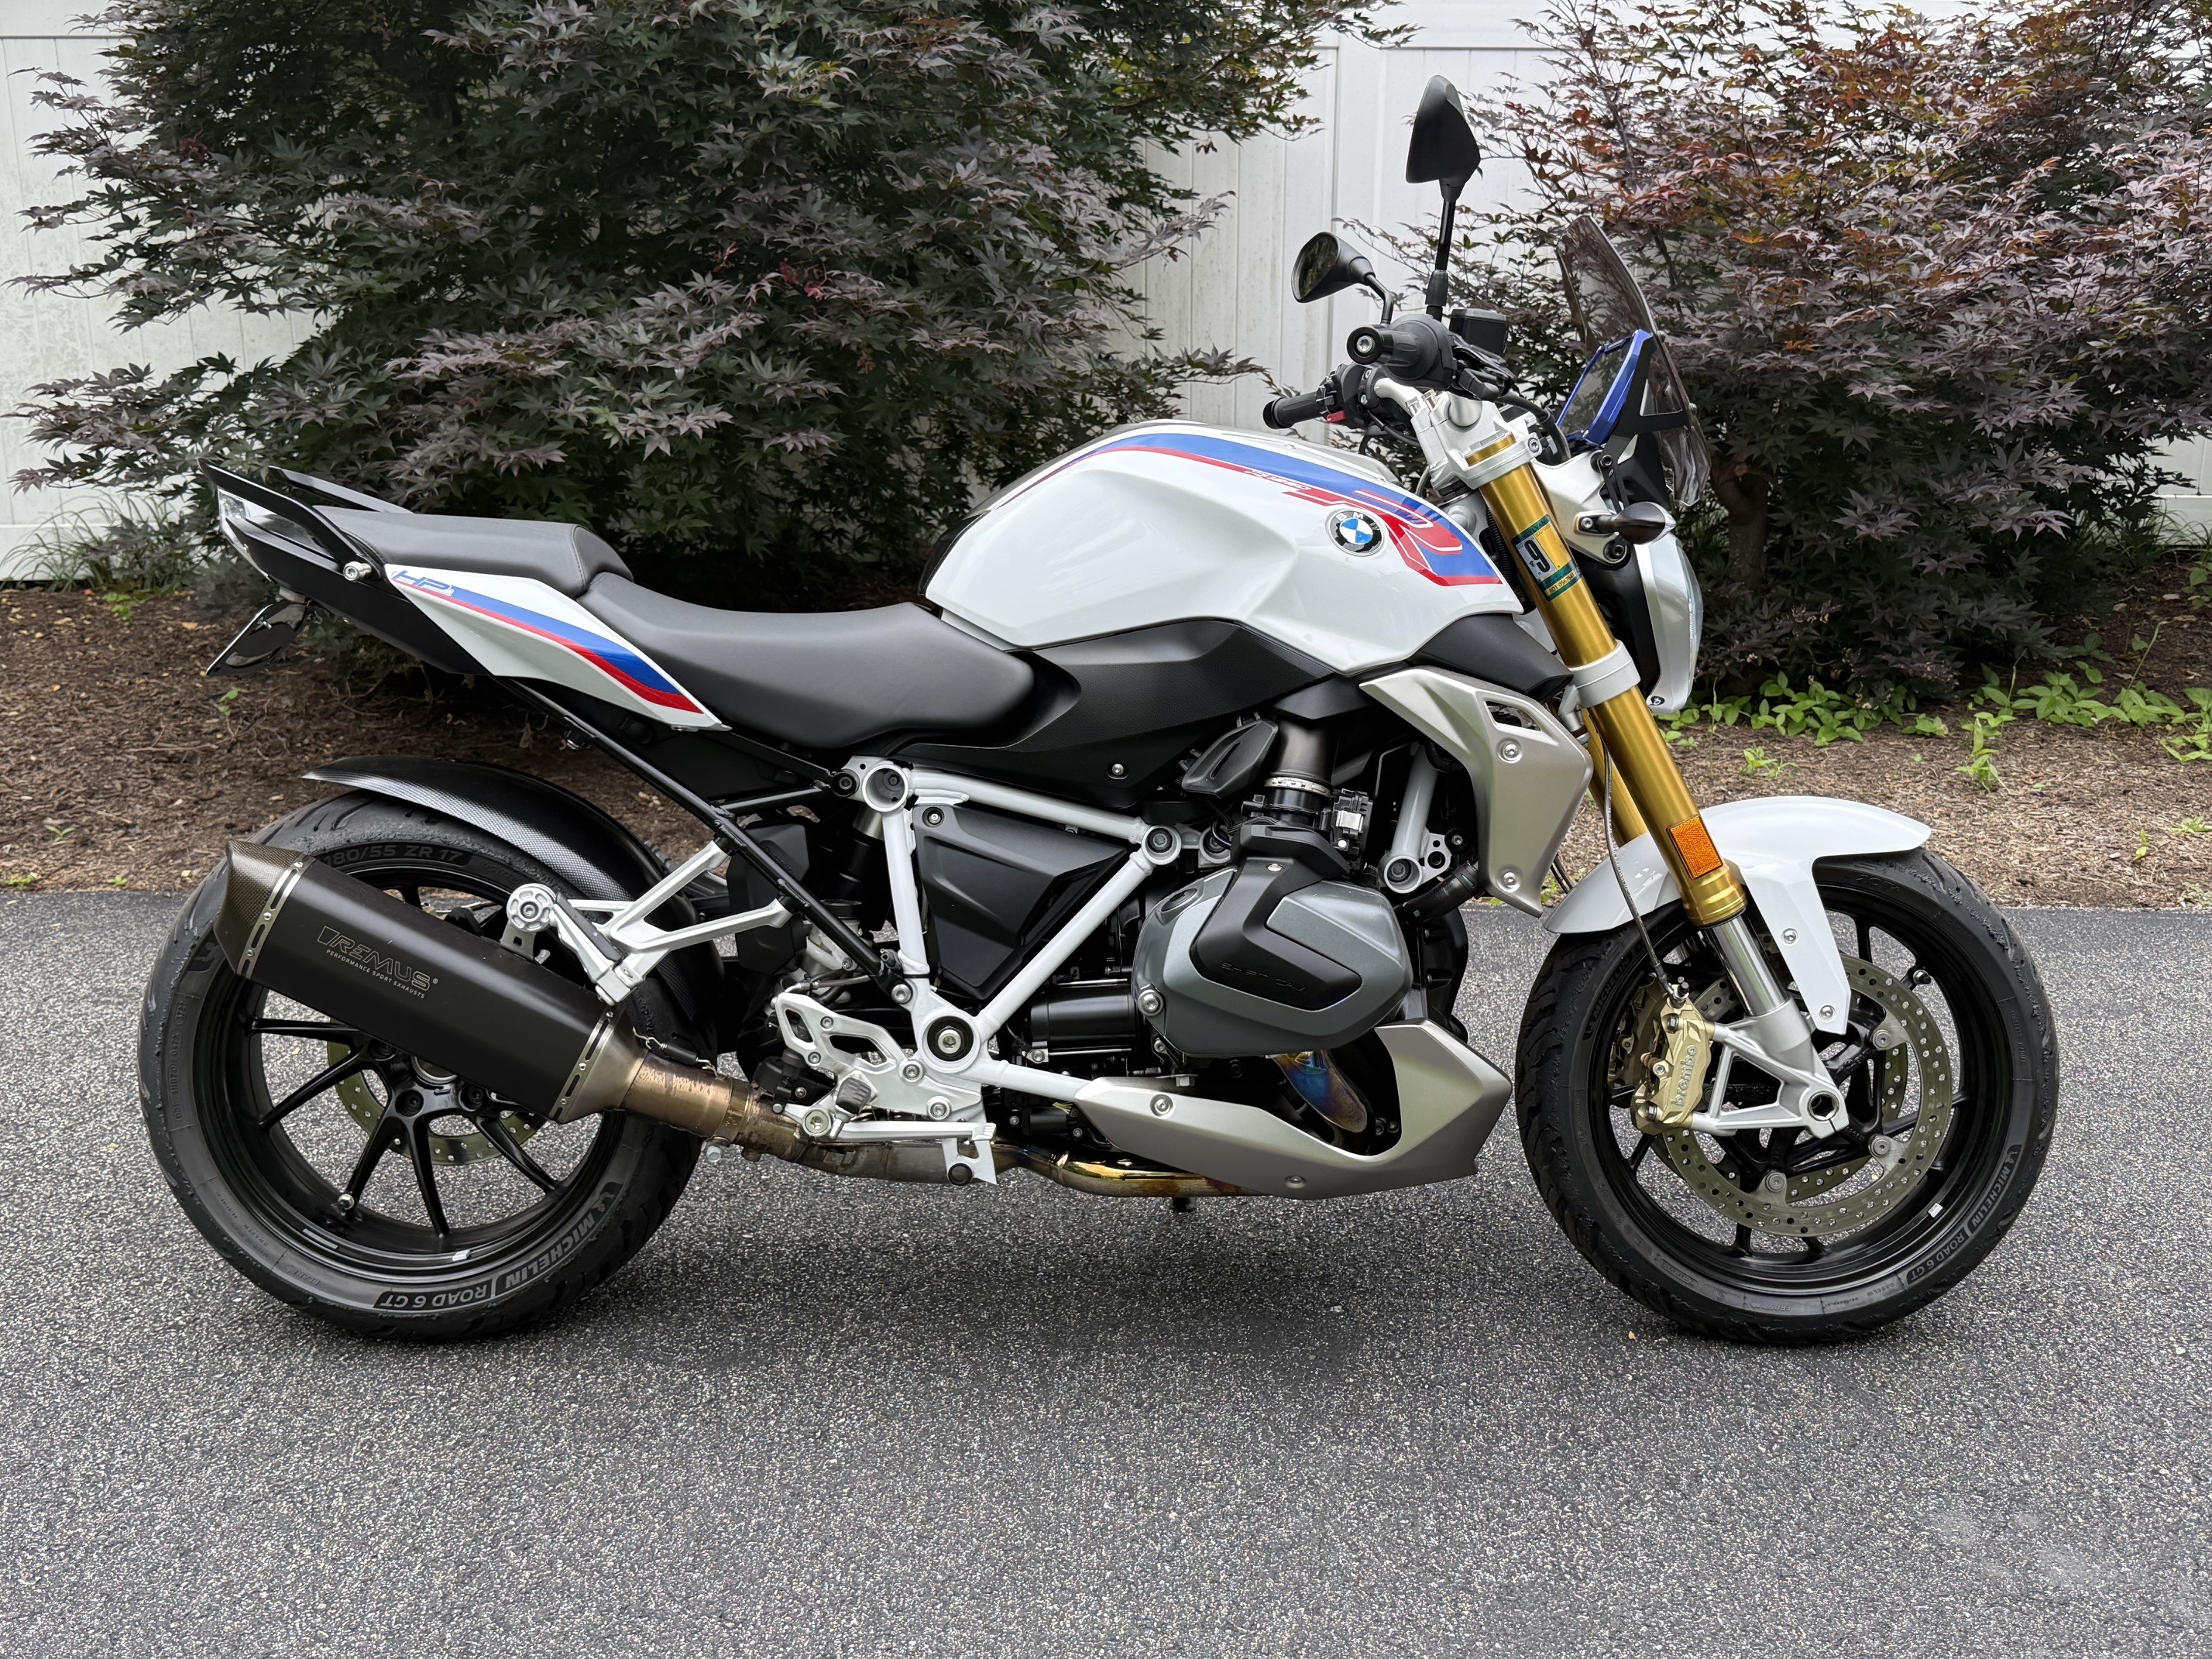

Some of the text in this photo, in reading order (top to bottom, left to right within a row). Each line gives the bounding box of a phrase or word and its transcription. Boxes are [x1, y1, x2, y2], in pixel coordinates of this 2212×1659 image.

[1335, 512, 1380, 531] BMW
[391, 570, 452, 590] HP
[1523, 539, 1551, 573] 9
[404, 845, 434, 858] ZR
[439, 849, 464, 861] 17
[326, 949, 425, 999] PERFORMANCE SPORT EXHAUSTS
[331, 934, 431, 991] REMUS
[1592, 959, 1630, 1018] MICHELIN
[1670, 1044, 1698, 1107] brembo
[1910, 1166, 2011, 1281] MICHELIN ROAD 6 GT
[380, 1213, 596, 1308] MICHELIN ROAD 6 GT
